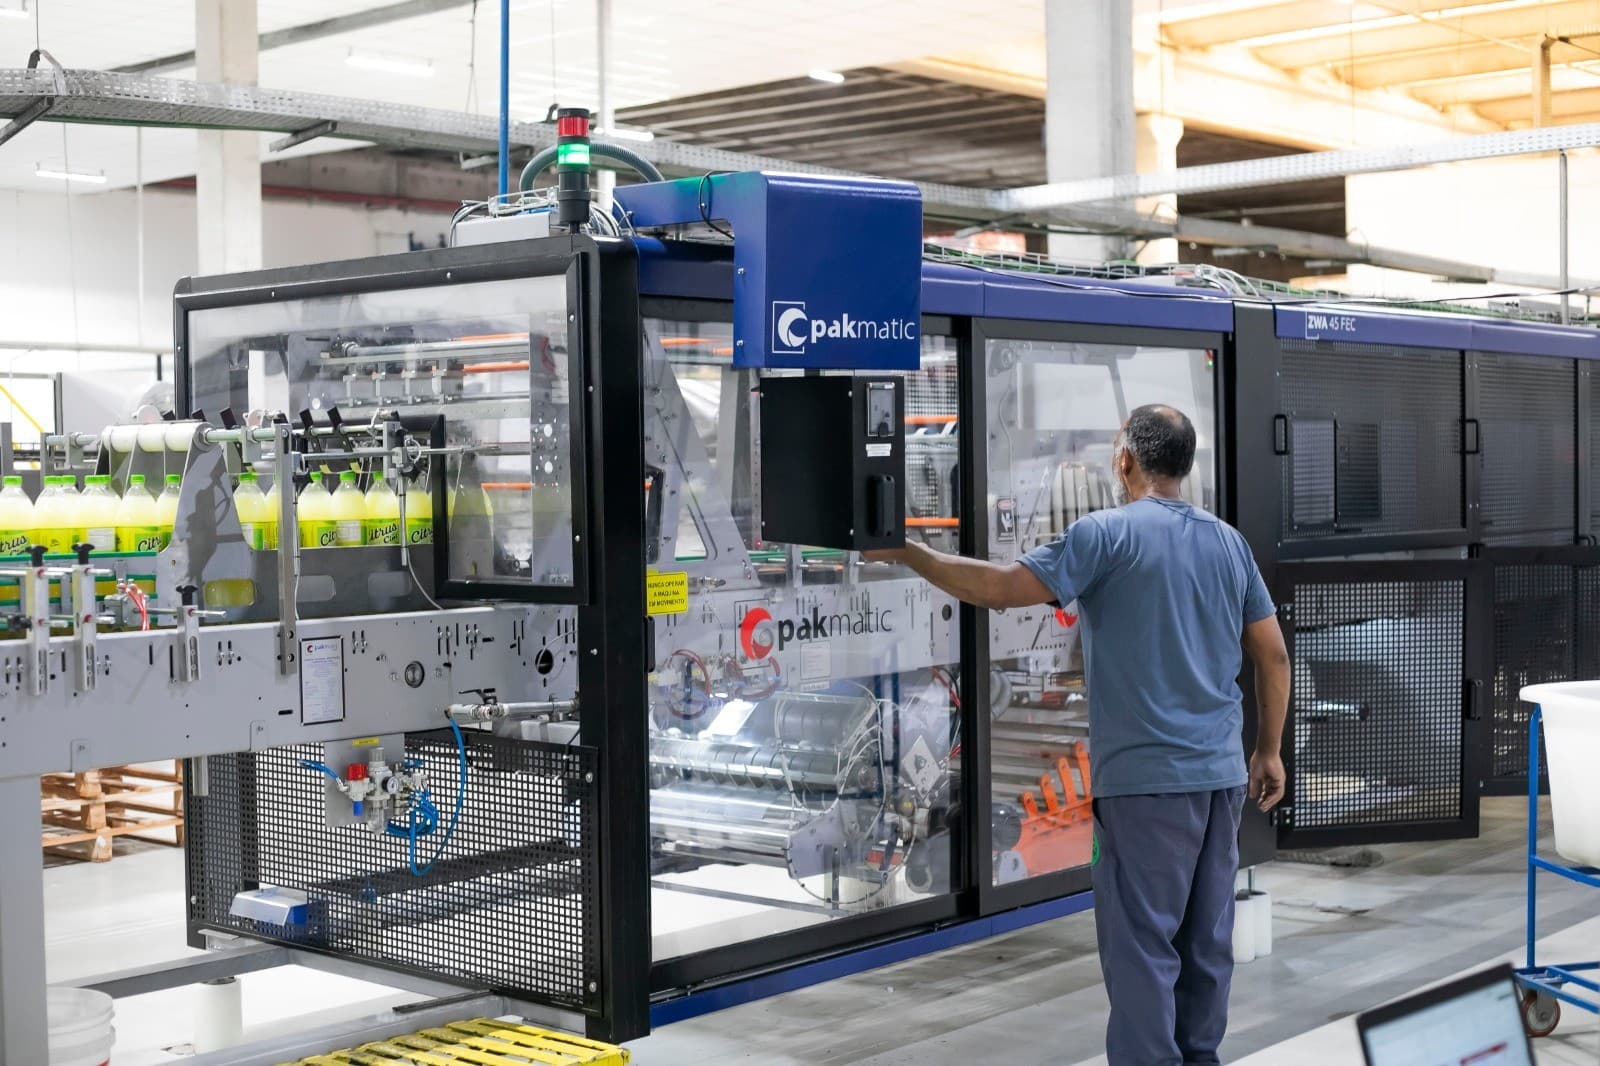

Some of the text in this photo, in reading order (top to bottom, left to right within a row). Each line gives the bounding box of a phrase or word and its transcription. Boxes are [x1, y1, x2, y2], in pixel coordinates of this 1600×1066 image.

[811, 313, 916, 344] pakmatic
[1308, 315, 1357, 332] ZWA 45 FEC
[371, 523, 397, 541] itrus
[0, 535, 28, 553] trus
[778, 607, 893, 652] pakmatic
